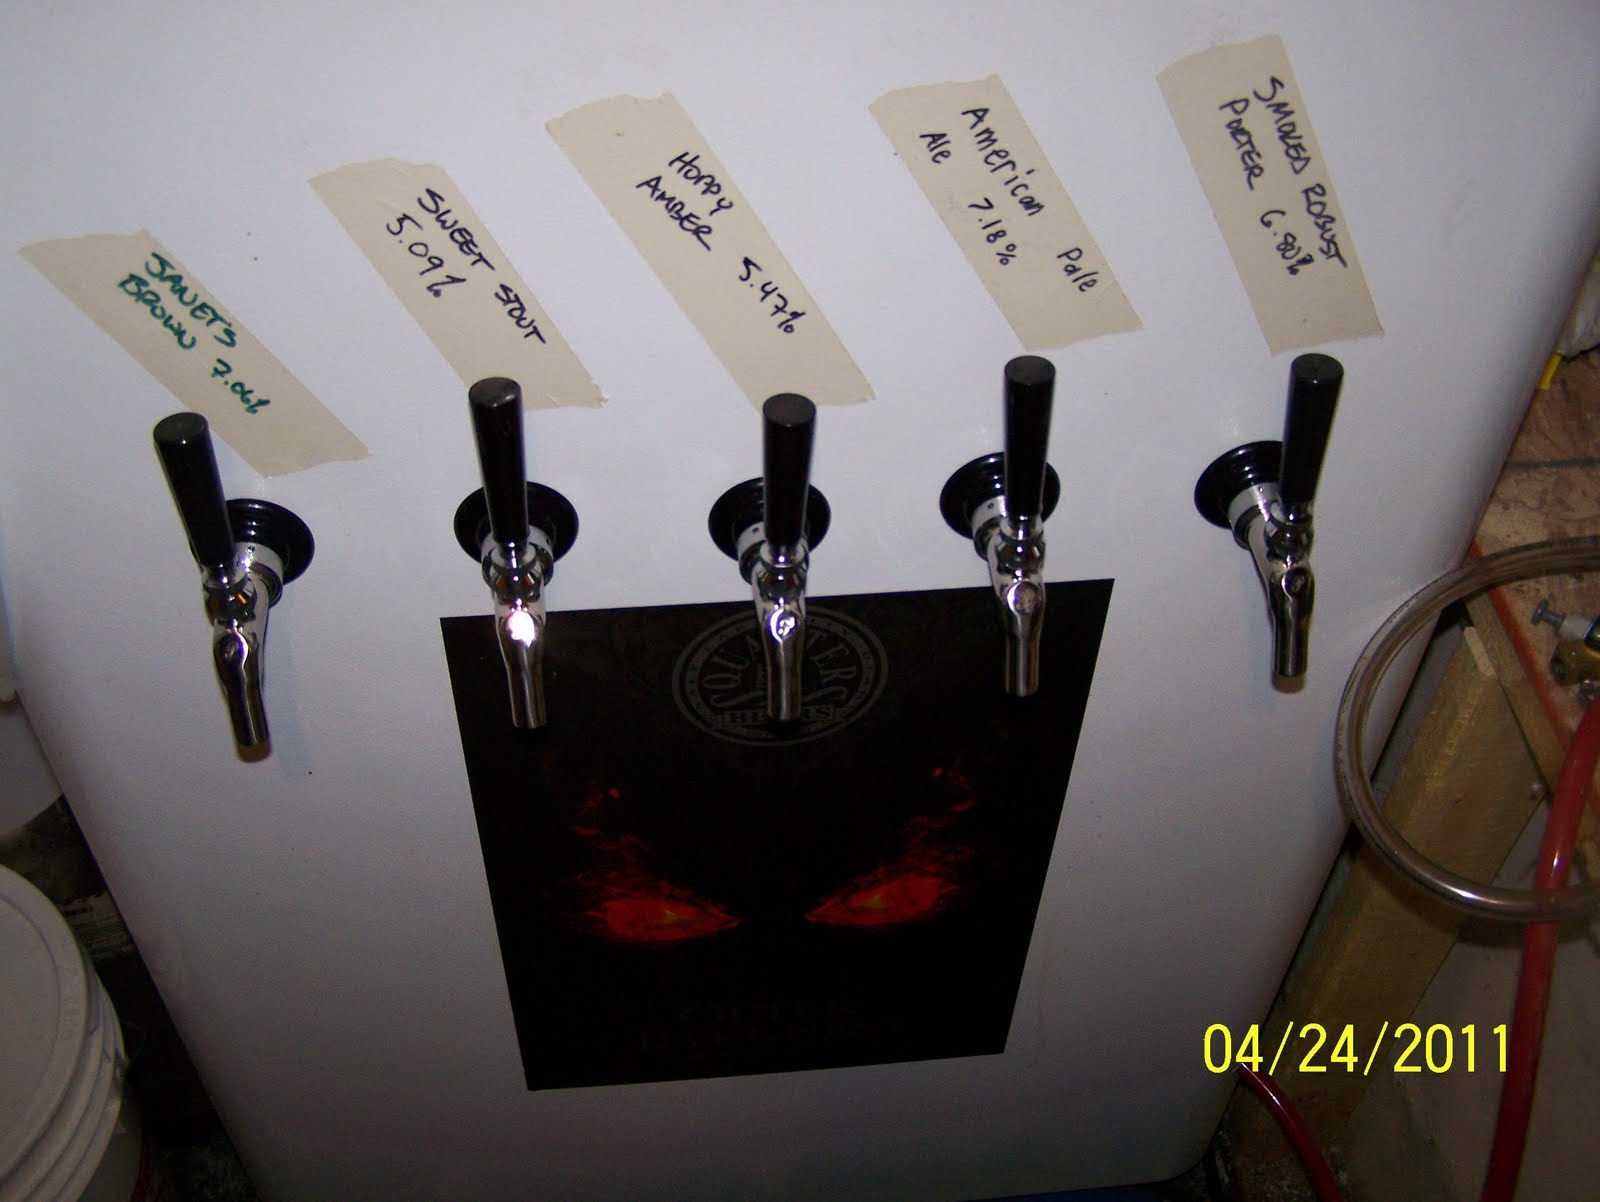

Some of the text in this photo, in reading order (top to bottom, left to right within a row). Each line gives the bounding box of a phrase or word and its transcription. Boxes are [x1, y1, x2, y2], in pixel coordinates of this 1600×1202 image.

[667, 151, 734, 216] HOPPY
[919, 132, 1018, 266] Ale 7.18%
[961, 107, 1099, 293] American Pale
[1218, 97, 1265, 191] PORTER
[1252, 75, 1348, 269] SMOKED ROBUST
[117, 272, 197, 350] BROWN
[386, 213, 467, 298] 5.09%
[417, 187, 547, 344] SWEET STOUT
[635, 175, 806, 334] AMBER 5.47%
